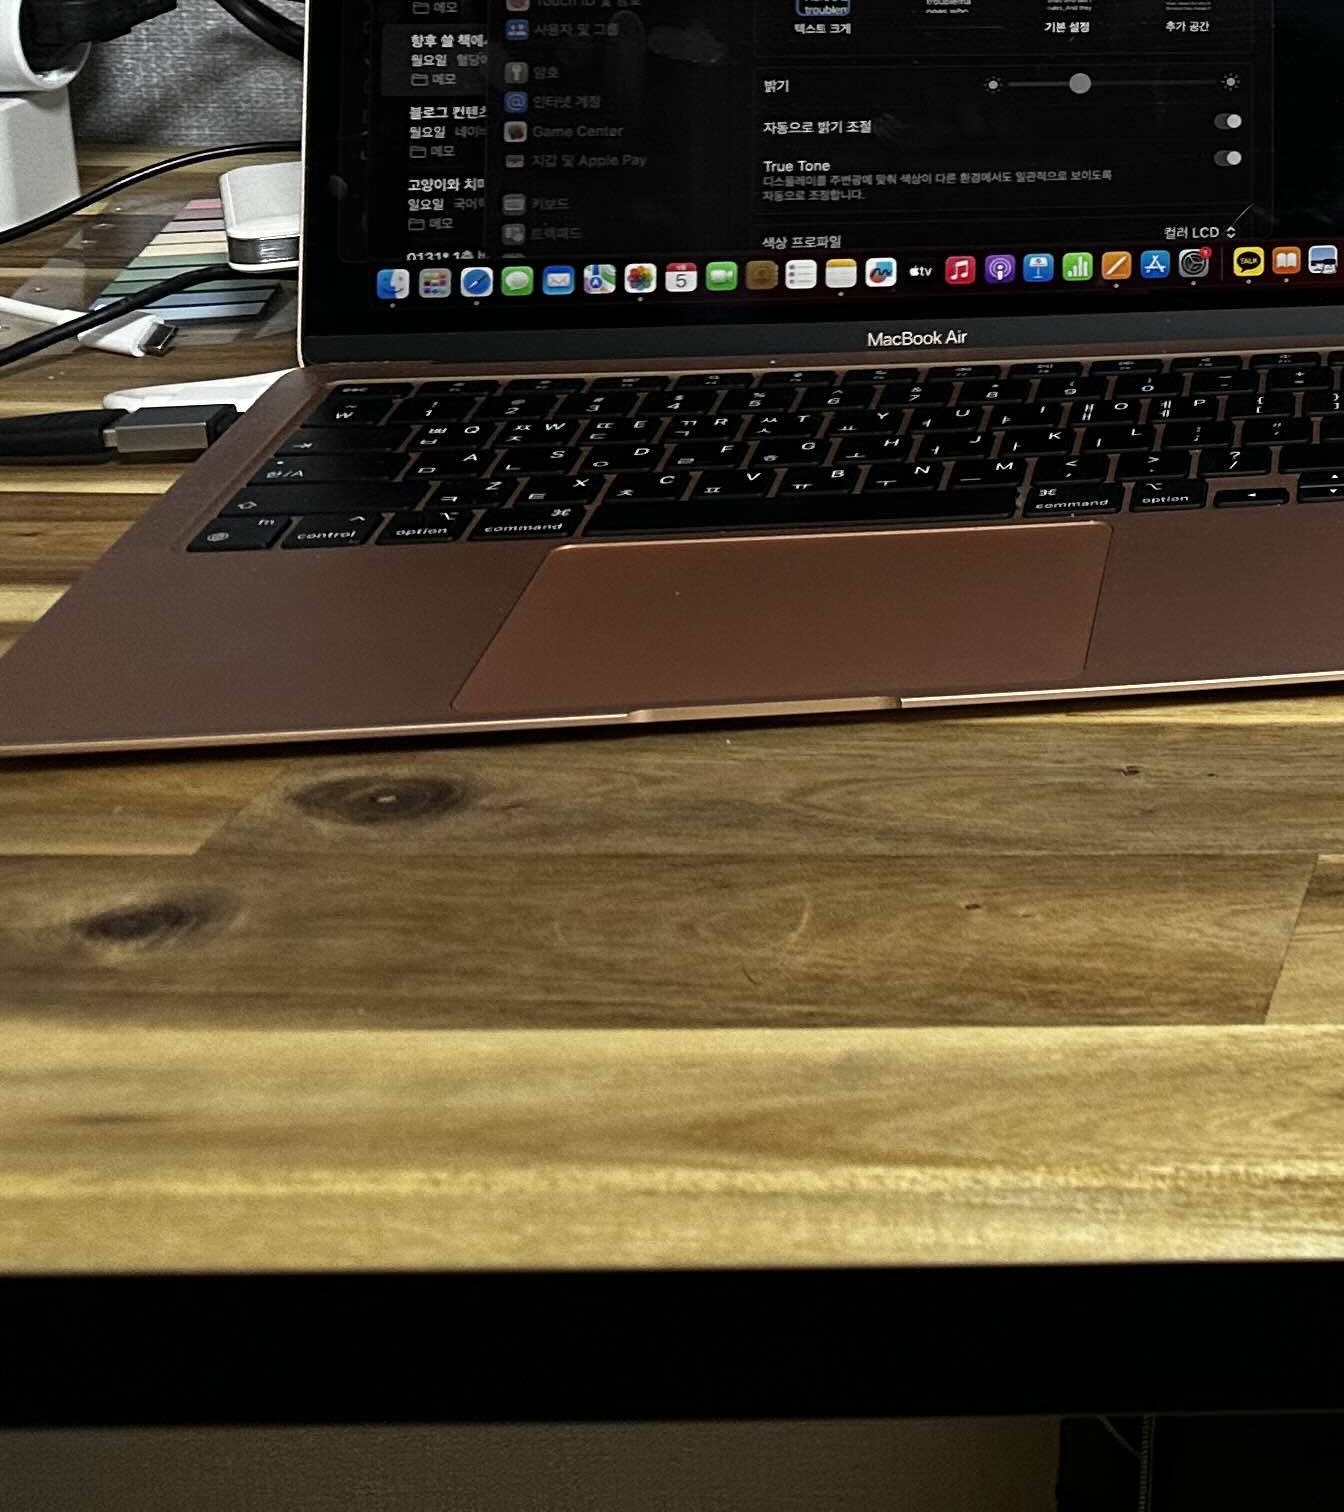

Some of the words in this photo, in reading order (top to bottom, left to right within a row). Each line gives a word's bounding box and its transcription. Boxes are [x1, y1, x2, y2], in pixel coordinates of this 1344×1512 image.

[433, 1, 458, 15] 메모
[794, 22, 827, 35] 텍스트
[830, 22, 852, 35] 크게
[1044, 21, 1067, 33] 기본
[1165, 20, 1187, 33] 추가
[1189, 20, 1209, 33] 공간
[410, 34, 436, 48] 향후
[410, 54, 447, 68] 월요일
[431, 72, 457, 86] 메모
[763, 80, 790, 94] 밝기
[408, 105, 449, 120] 블로그
[408, 125, 446, 139] 월요일
[532, 124, 573, 138] Game
[576, 124, 624, 138] Center
[763, 119, 814, 135] 자동으로
[817, 119, 844, 134] 밝기
[846, 118, 872, 134] 조절
[430, 144, 456, 158] 메모
[578, 153, 619, 169] Apple
[622, 153, 648, 169] Pay
[763, 160, 794, 172] True
[797, 160, 831, 172] Tone
[407, 177, 461, 193] 고양이와
[407, 197, 444, 211] 일요일
[428, 216, 455, 230] 메모
[1163, 226, 1189, 240] 컬러
[1192, 225, 1220, 239] LCD
[762, 235, 788, 250] 색상
[791, 234, 842, 249] 프로파일
[867, 330, 942, 348] MacBook
[946, 329, 968, 345] Air
[1034, 498, 1109, 510] command
[1142, 494, 1189, 505] option
[395, 526, 448, 537] option
[484, 522, 563, 533] command
[297, 529, 357, 541] control
